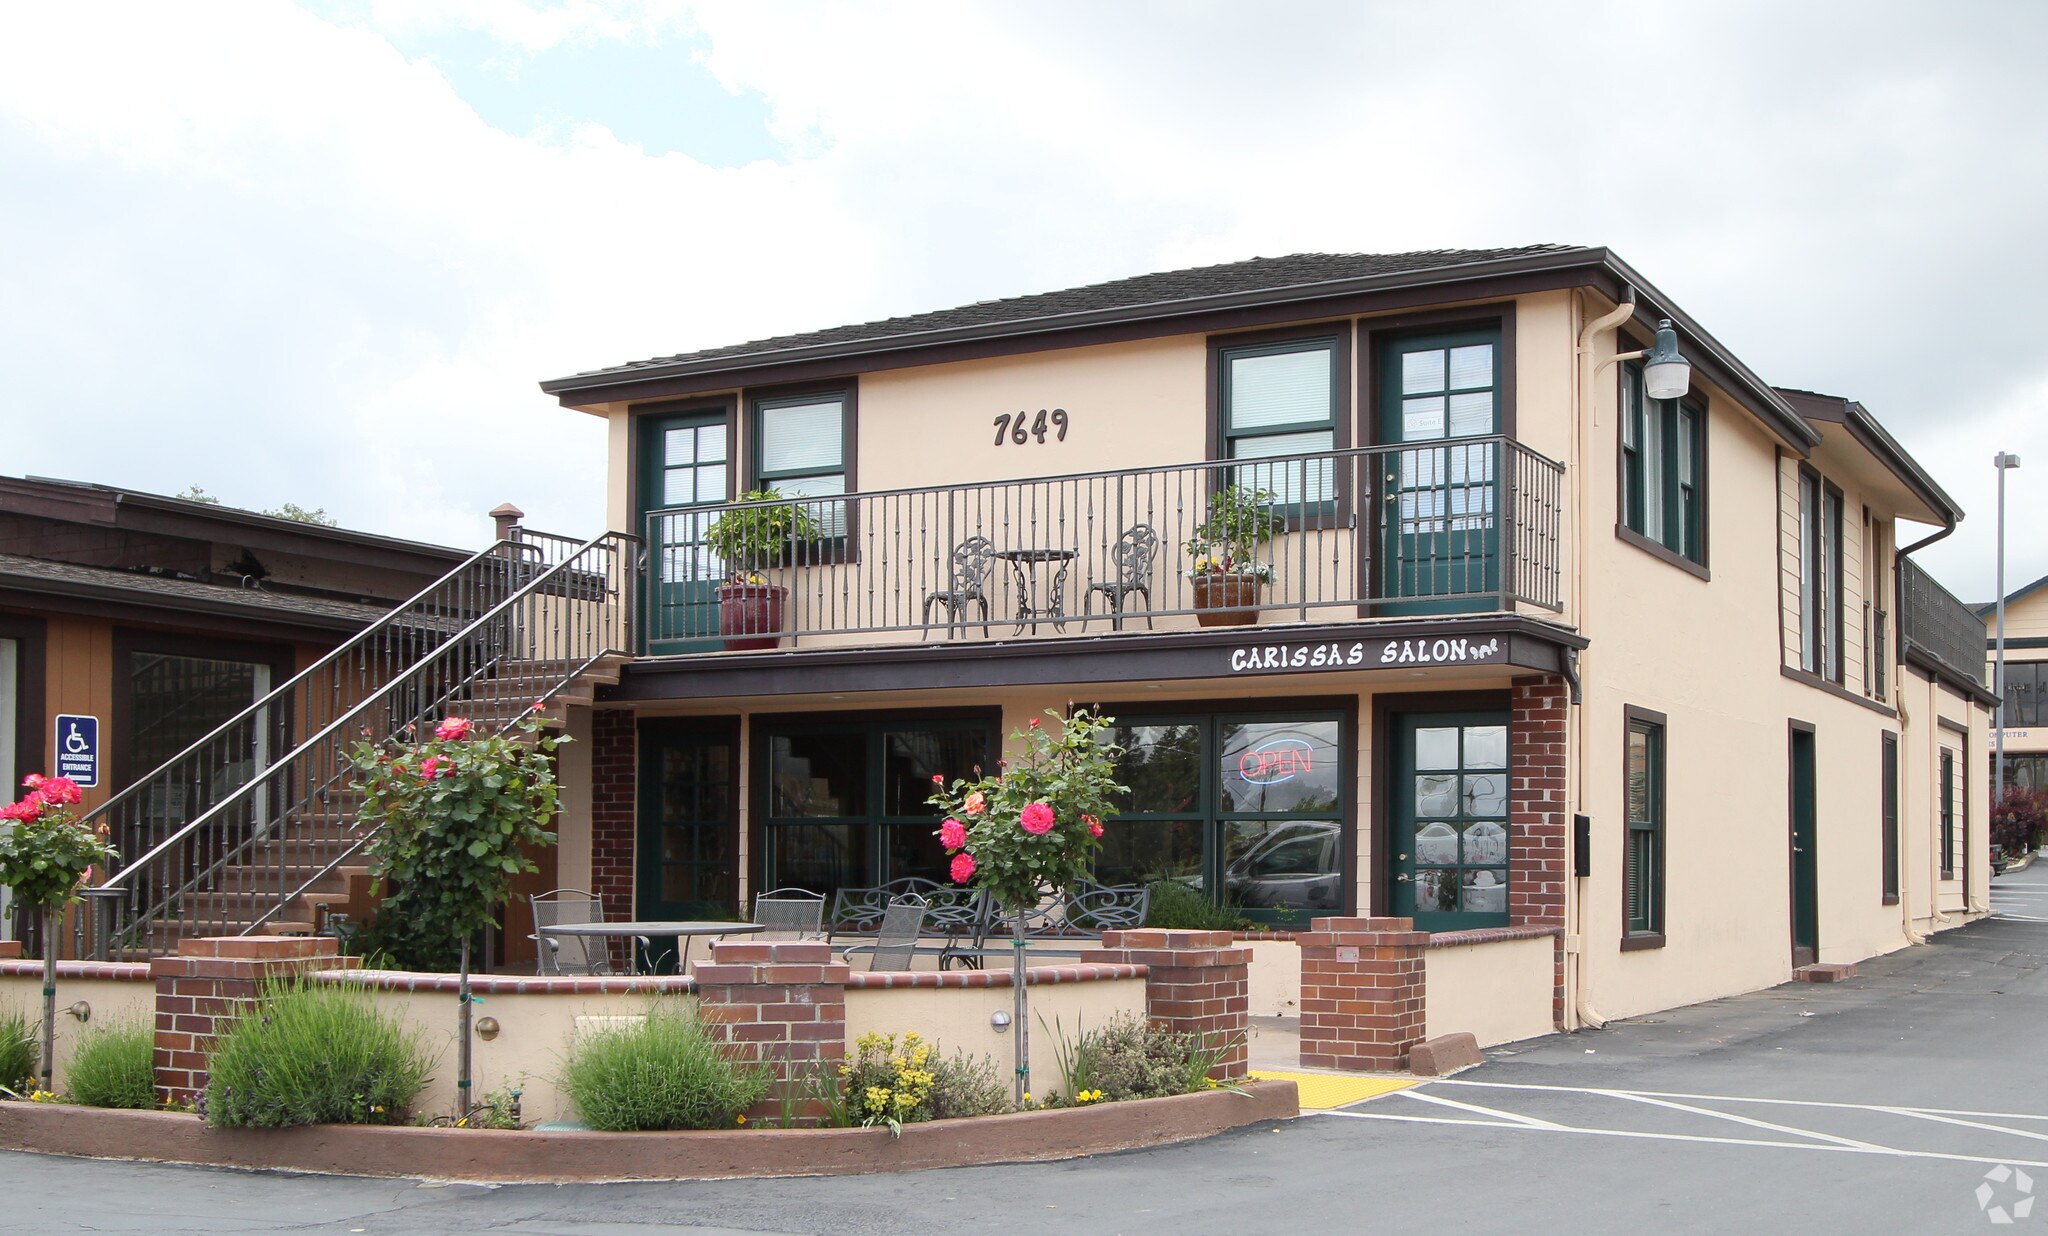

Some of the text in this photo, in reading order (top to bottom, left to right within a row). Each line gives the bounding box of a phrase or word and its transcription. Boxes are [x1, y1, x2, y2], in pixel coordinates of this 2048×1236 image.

[993, 408, 1069, 446] 7649
[1231, 638, 1468, 671] CARISSAS SALON
[60, 753, 94, 762] ACCESSIBLE
[62, 763, 92, 771] ENTRANCE
[1240, 748, 1312, 777] OPEN
